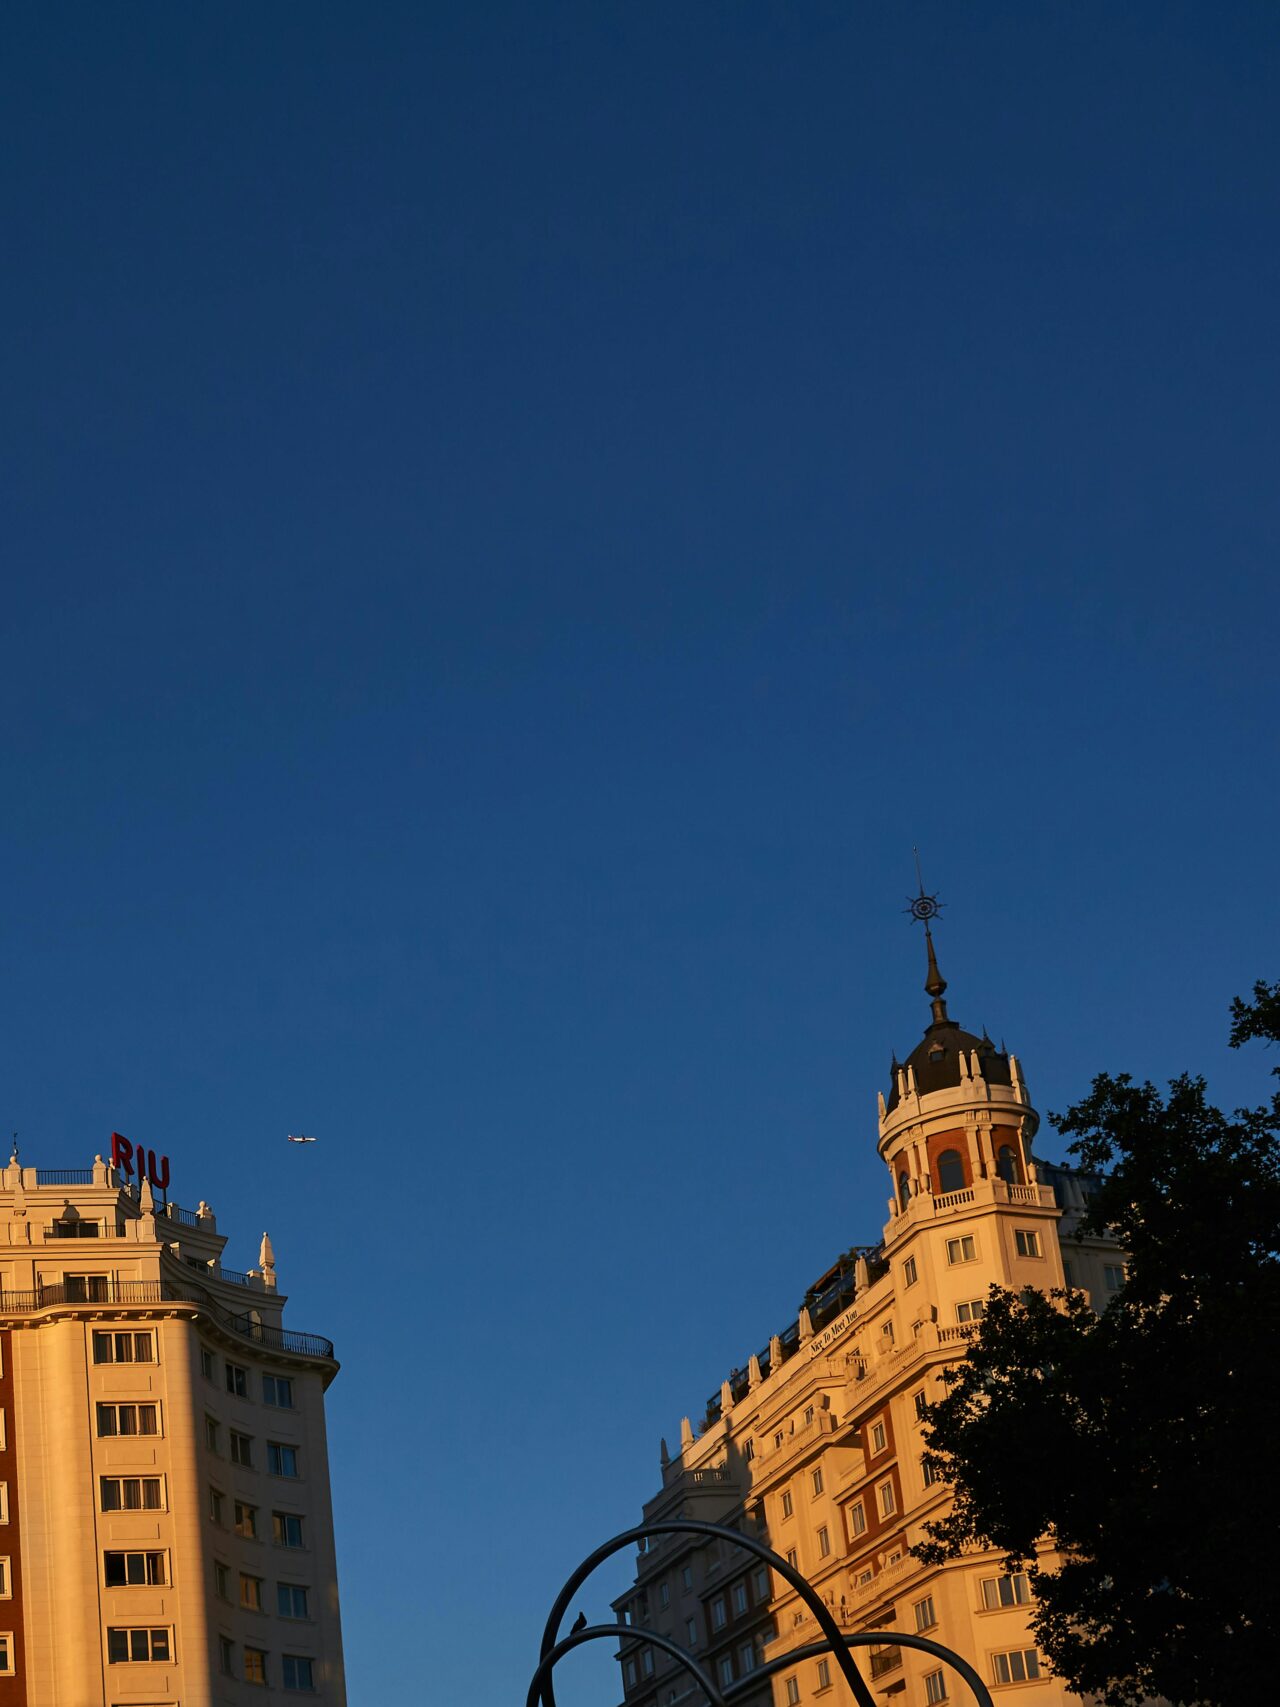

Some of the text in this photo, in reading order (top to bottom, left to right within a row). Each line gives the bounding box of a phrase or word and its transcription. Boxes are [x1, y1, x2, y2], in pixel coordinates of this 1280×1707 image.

[111, 1132, 169, 1189] RIU
[811, 1310, 858, 1352] Nice To Meet You
